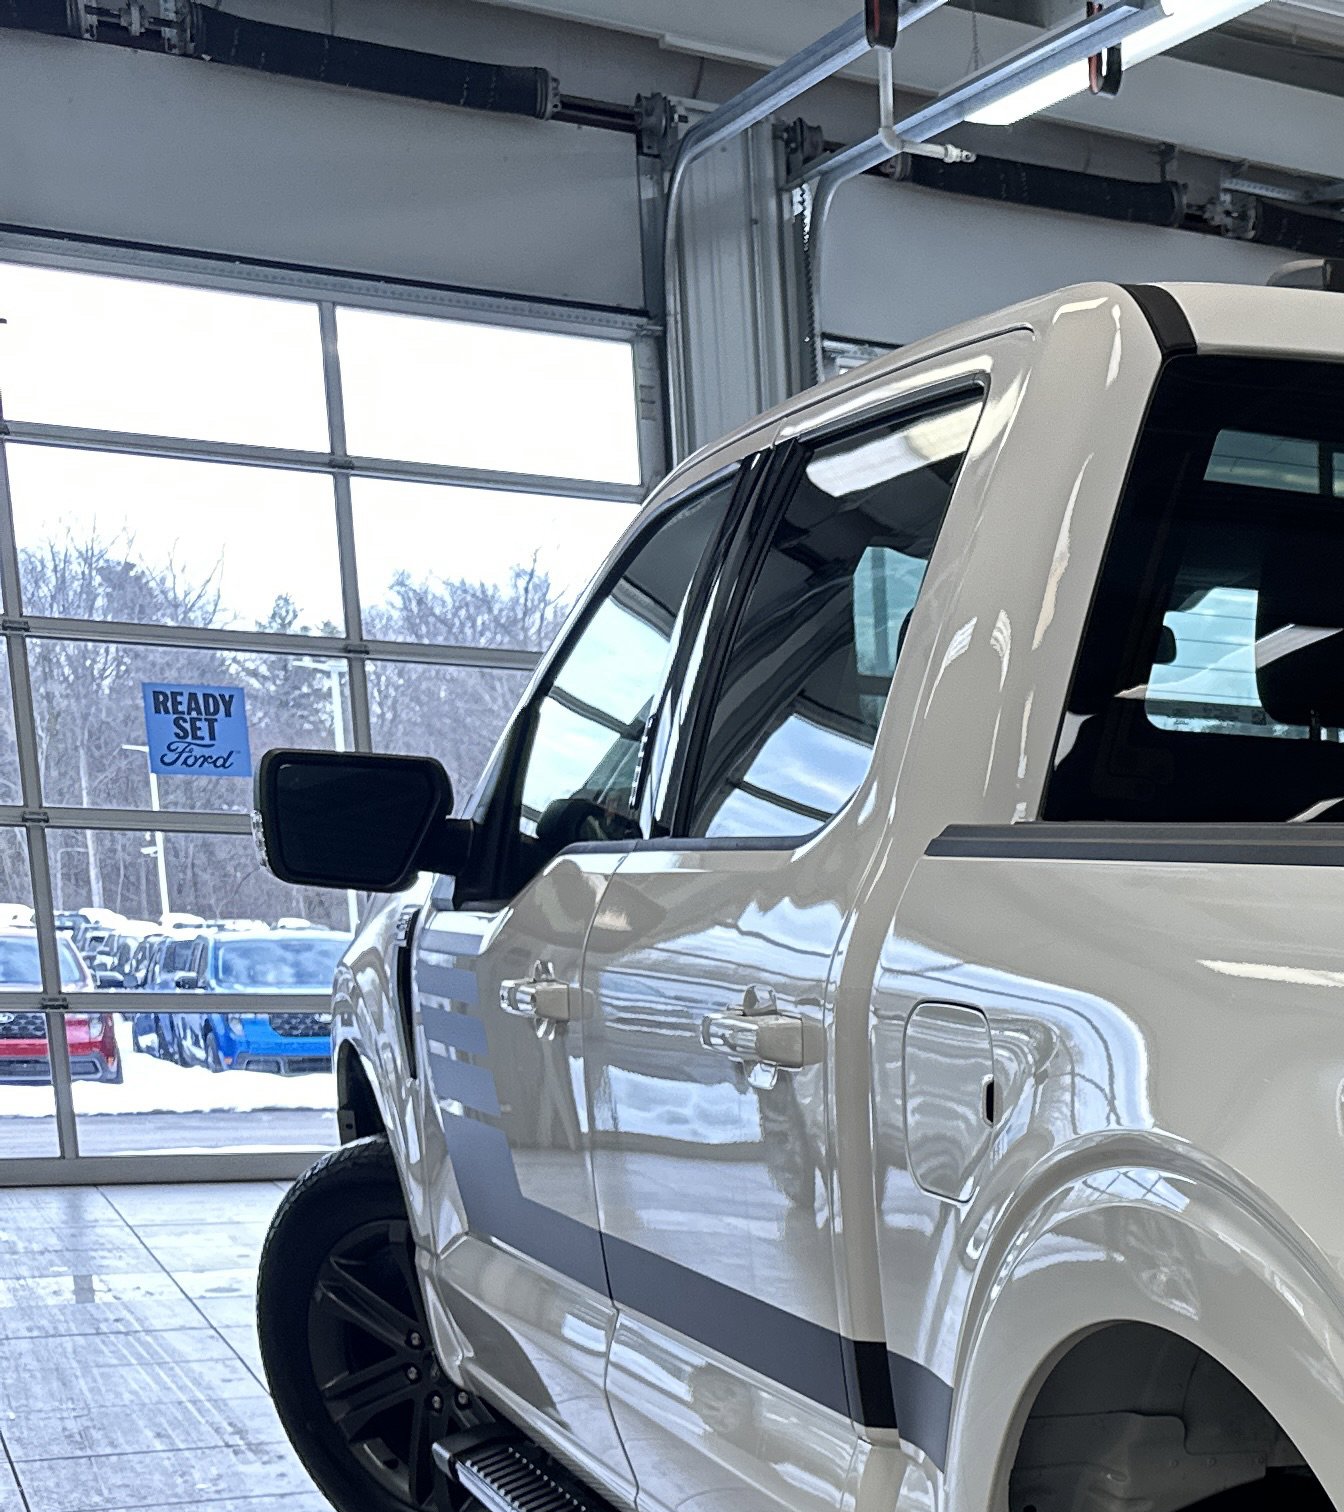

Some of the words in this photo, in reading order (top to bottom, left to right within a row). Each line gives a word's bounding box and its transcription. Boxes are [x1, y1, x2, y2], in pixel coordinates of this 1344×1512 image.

[152, 690, 234, 718] READY
[172, 716, 218, 741] SET
[160, 740, 234, 769] Ford
